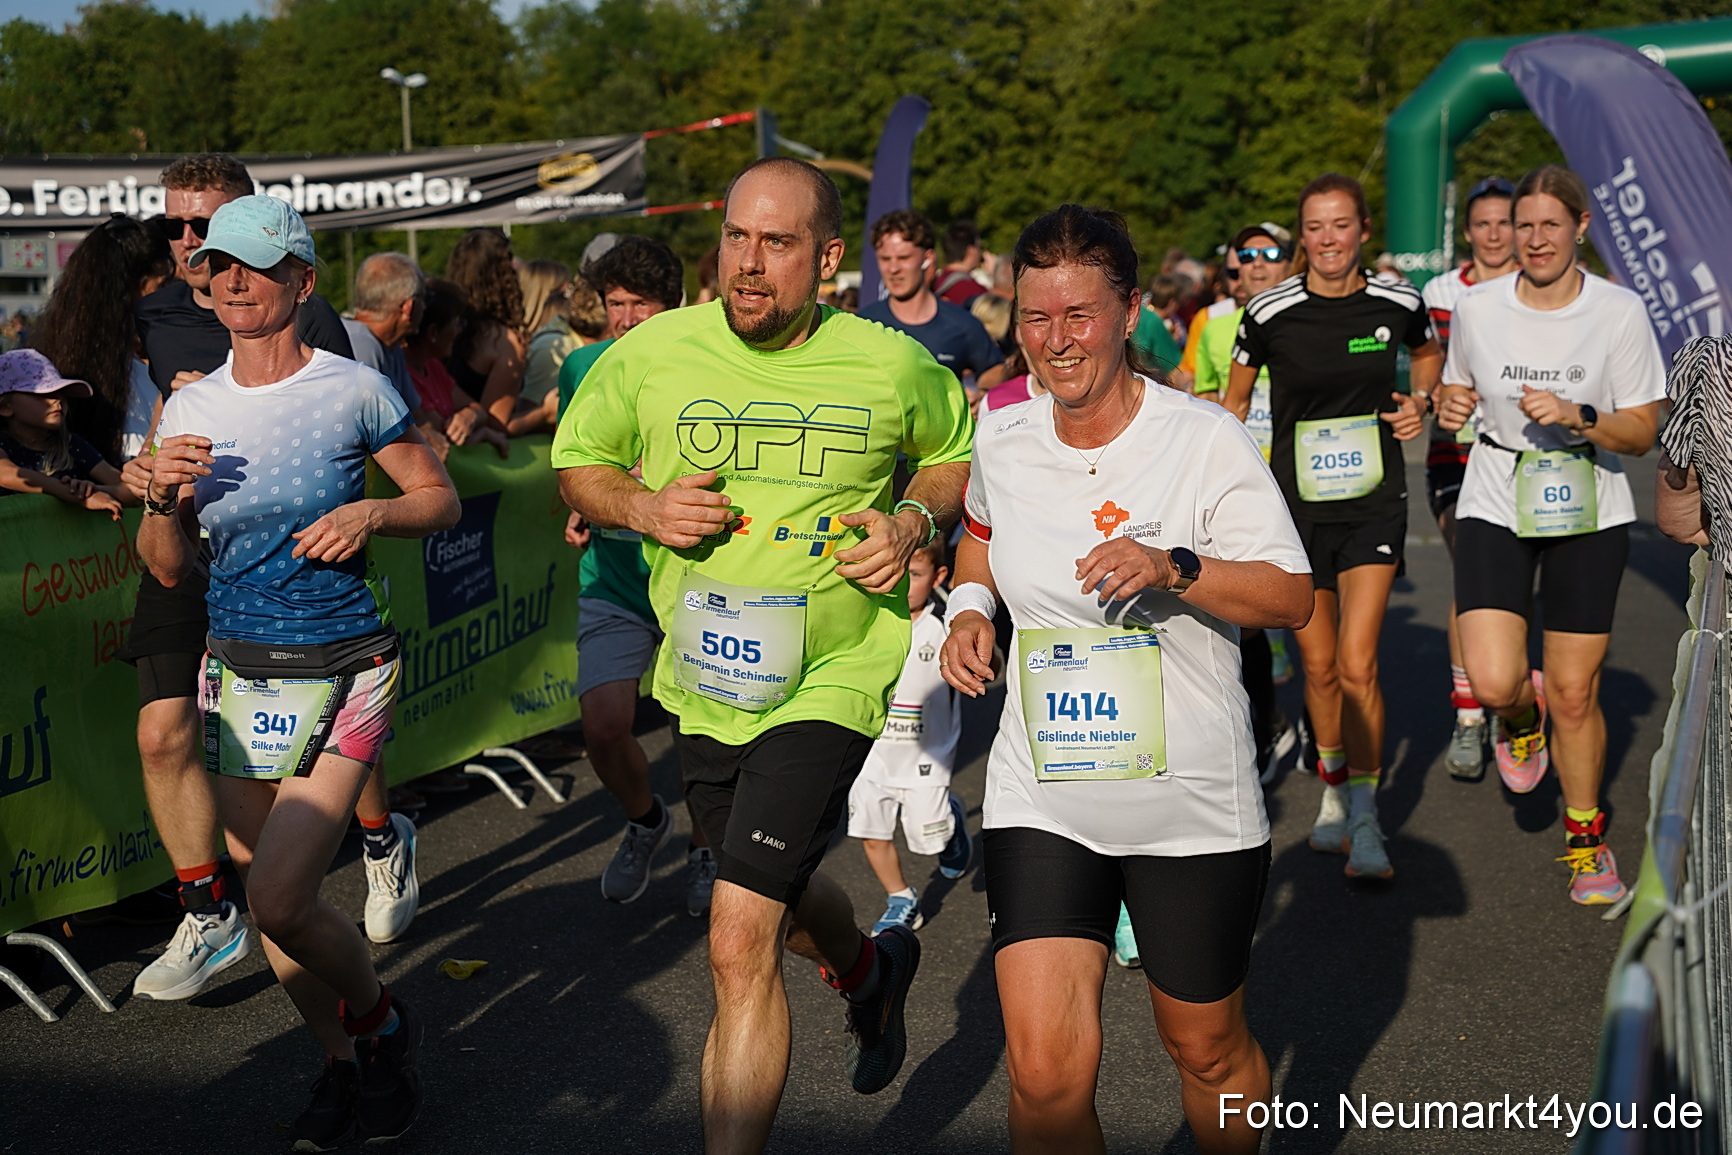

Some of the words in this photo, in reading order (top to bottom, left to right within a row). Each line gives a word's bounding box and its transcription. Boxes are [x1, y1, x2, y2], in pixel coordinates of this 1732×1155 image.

[1500, 365, 1561, 381] Allianz
[676, 398, 872, 478] OPF
[1310, 451, 1363, 470] 2056
[735, 474, 835, 491] Automatisierungstechnik
[1543, 485, 1571, 503] 60
[1101, 514, 1117, 524] NM
[1123, 521, 1162, 532] LANDKREIS
[1122, 529, 1162, 540] NEUMARKT
[437, 531, 484, 563] Fischer
[702, 603, 741, 616] Firmenlauf
[401, 562, 557, 700] firmenlauf
[701, 630, 762, 664] 505
[683, 653, 731, 676] Benjamin
[732, 668, 788, 684] Schindler
[1047, 657, 1089, 668] Firmenlauf
[249, 686, 280, 695] Firmenlauf
[404, 670, 475, 728] neumarkt
[1046, 692, 1119, 721] 1414
[252, 711, 298, 737] 341
[1037, 730, 1086, 742] Gislinde
[1090, 730, 1137, 742] Niebler
[251, 740, 274, 751] Silke
[762, 835, 786, 851] JAKO
